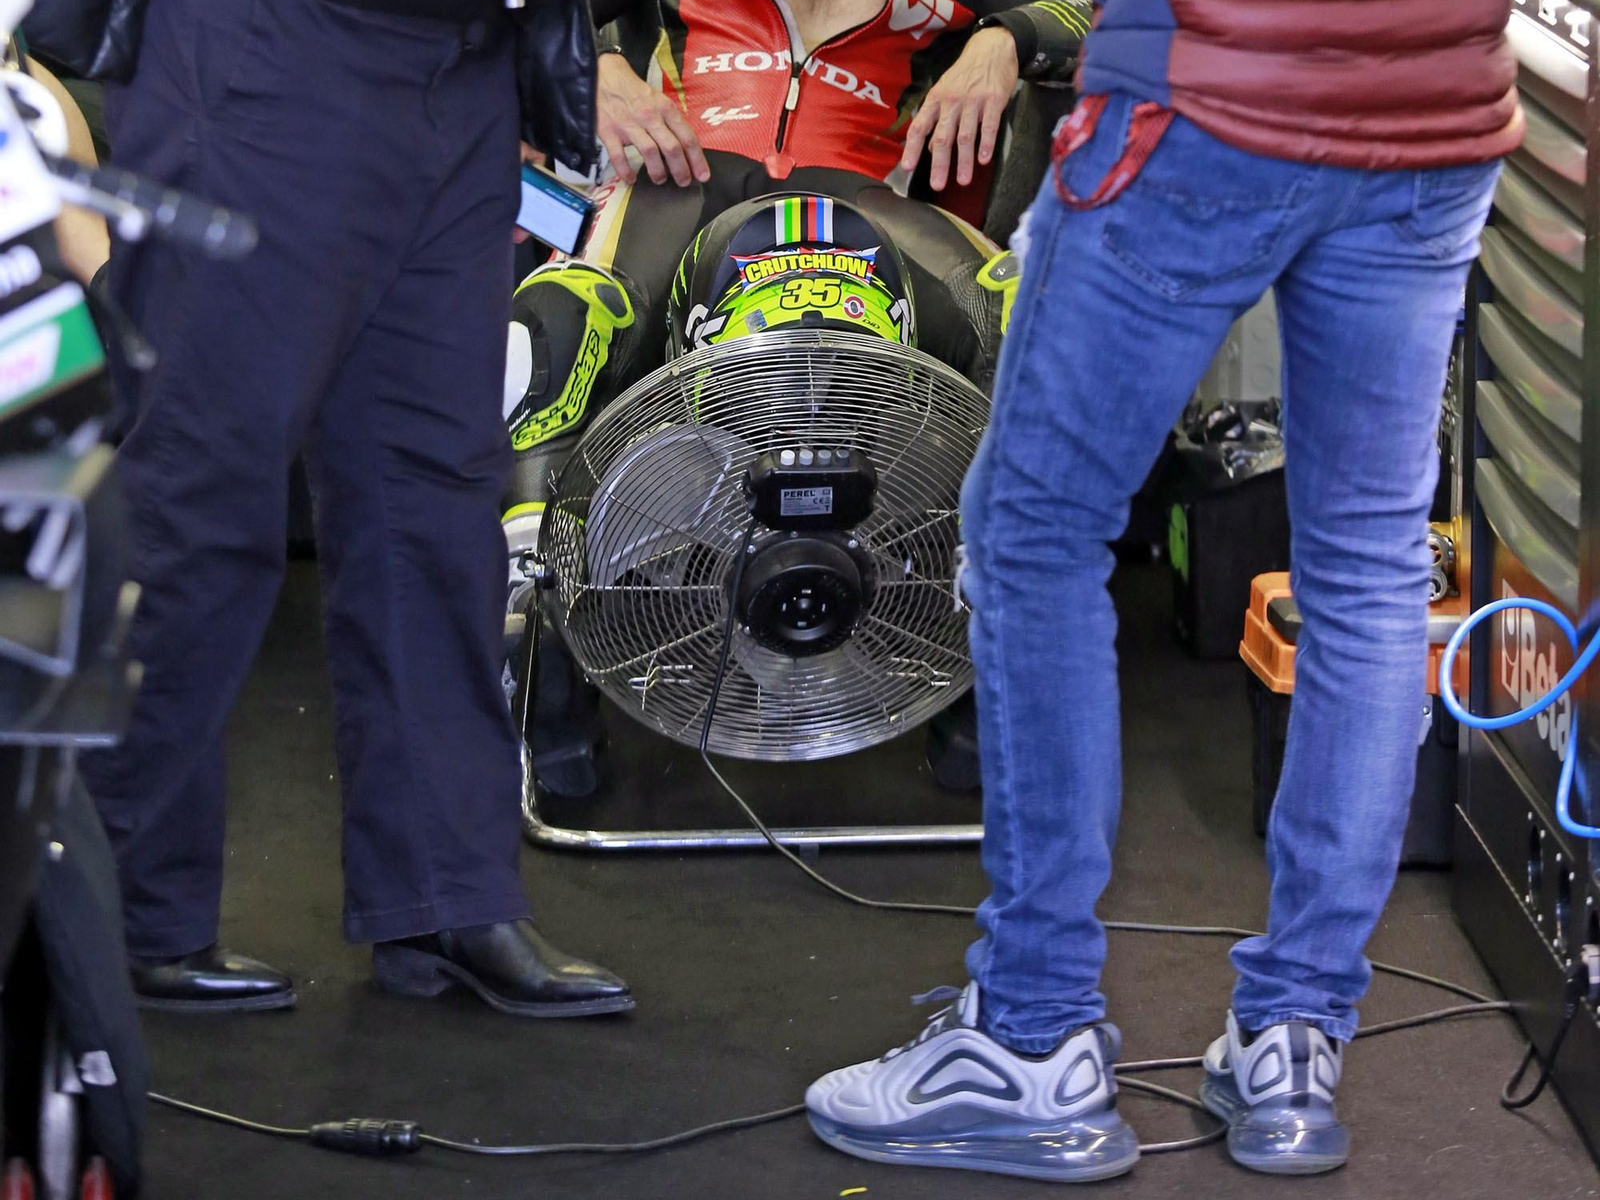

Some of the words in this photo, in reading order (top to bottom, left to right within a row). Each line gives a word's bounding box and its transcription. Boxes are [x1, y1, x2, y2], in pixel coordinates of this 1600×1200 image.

[694, 50, 890, 109] HONDA
[744, 254, 869, 284] CRUTCHLOW
[780, 279, 841, 310] 35
[784, 490, 815, 498] PEREL
[1521, 605, 1572, 762] Beta
